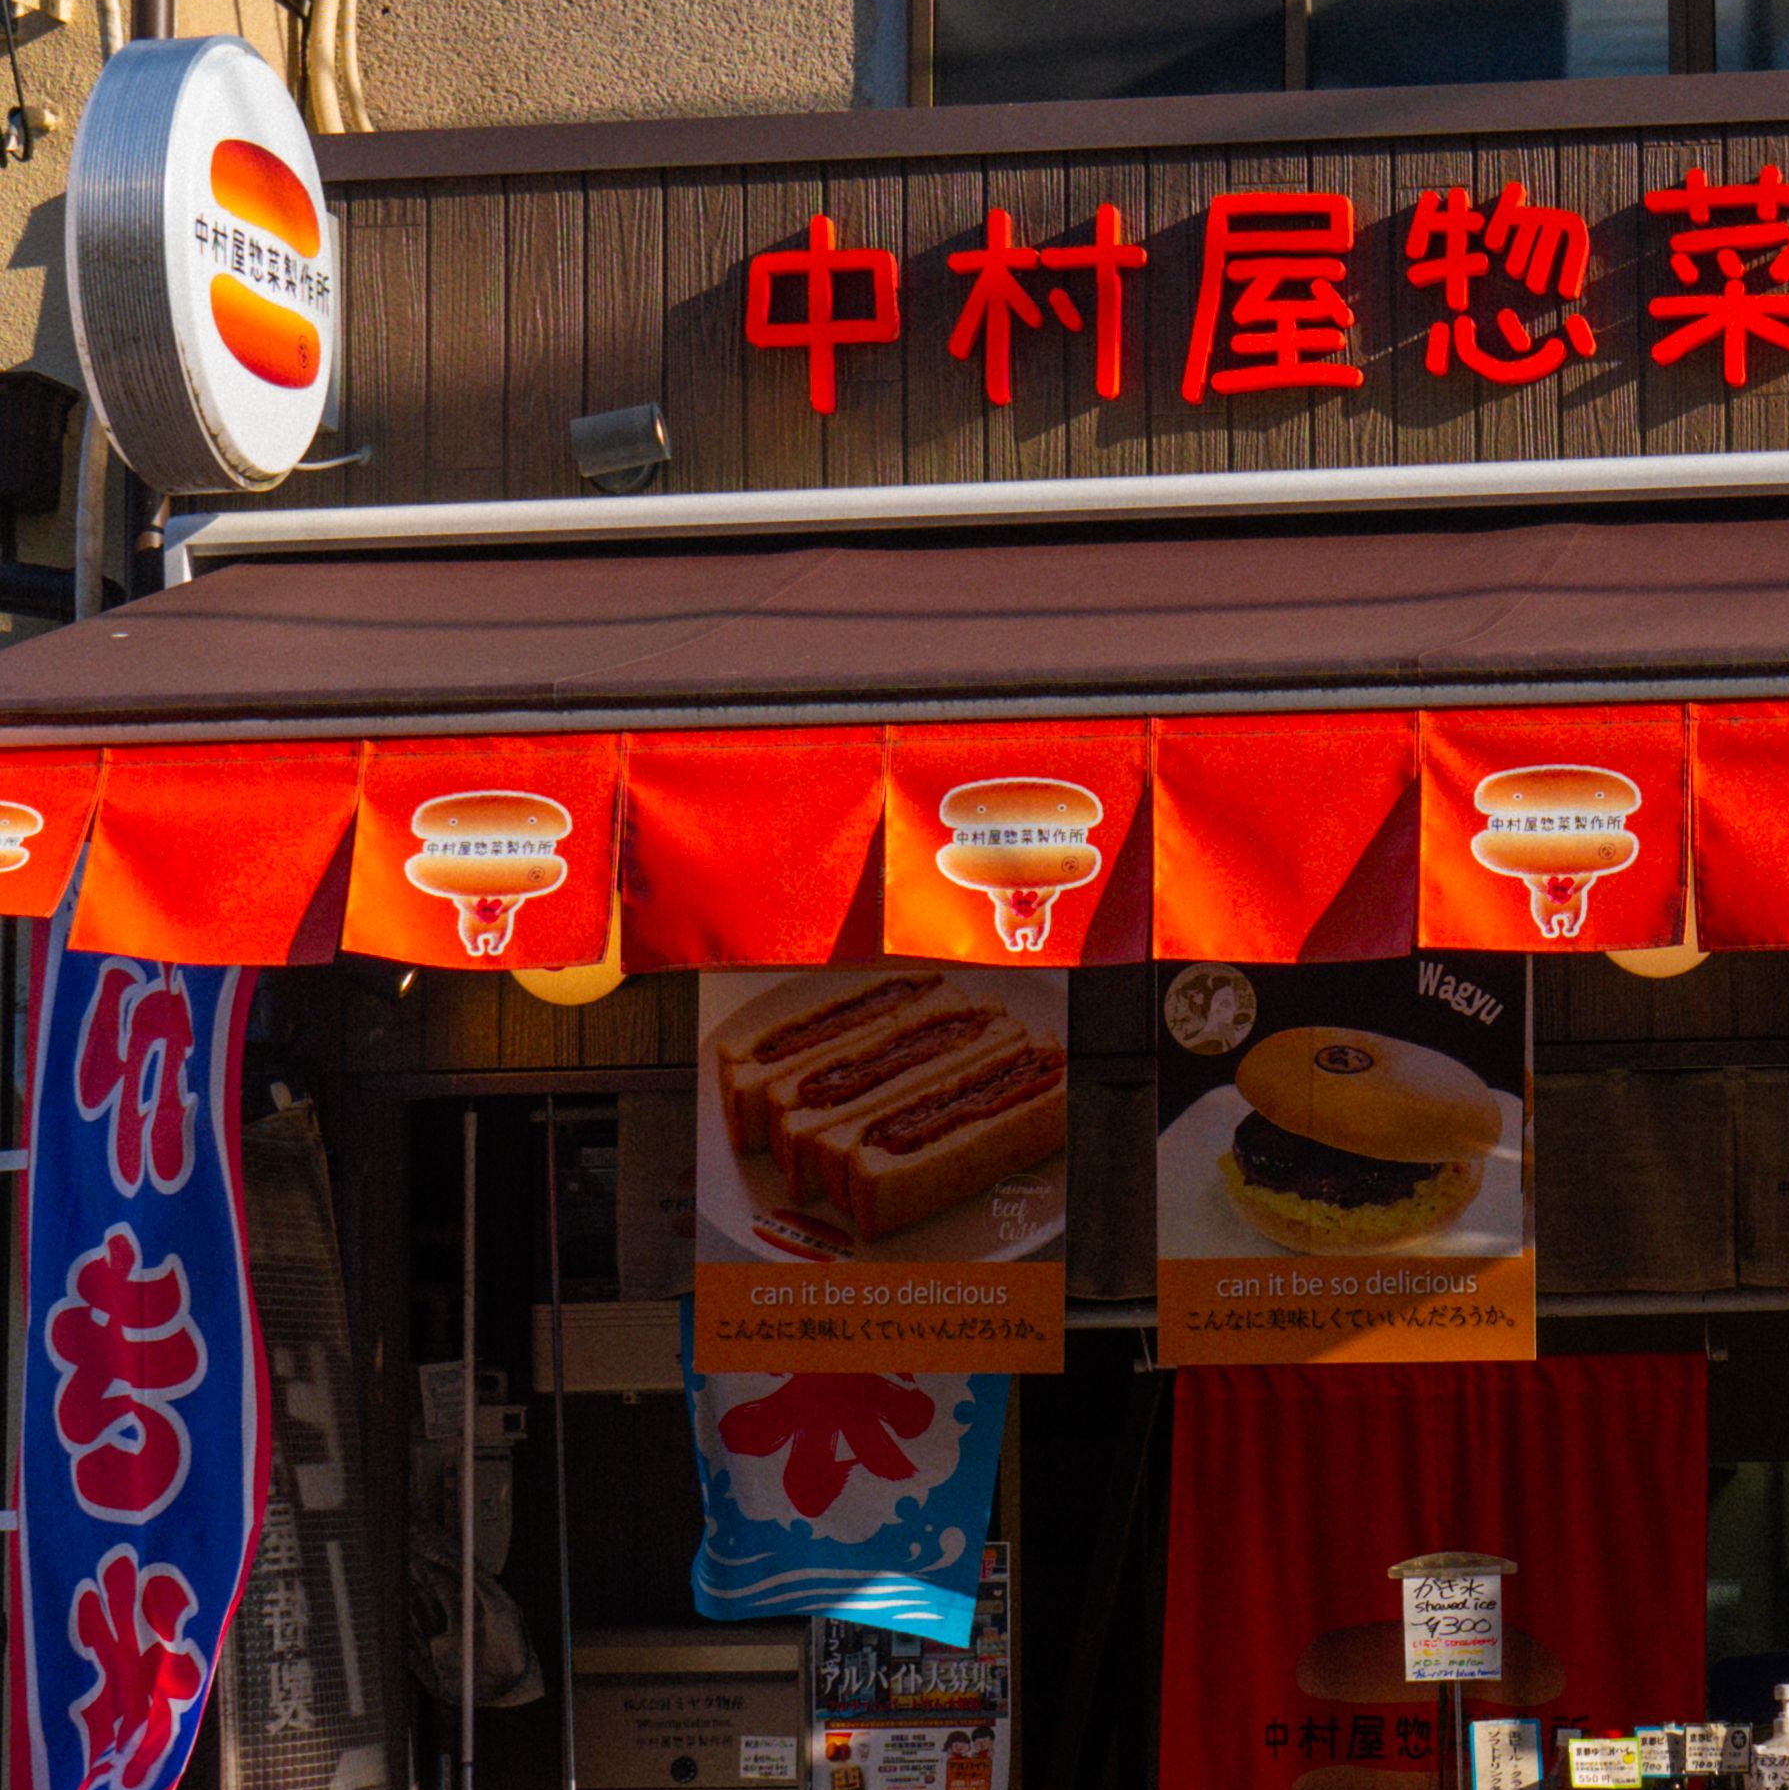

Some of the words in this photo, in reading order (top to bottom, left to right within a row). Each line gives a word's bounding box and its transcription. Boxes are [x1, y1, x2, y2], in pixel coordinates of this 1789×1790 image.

[196, 213, 330, 315] 中村屋惣菜製作所
[1491, 815, 1622, 832] 中村屋惣菜製作所
[427, 840, 553, 856] 中村屋惣菜製作所
[956, 828, 1085, 845] 中村屋惣菜製作所
[1417, 959, 1505, 1027] Wagyu
[751, 1286, 794, 1305] can
[802, 1281, 816, 1304] it
[825, 1281, 856, 1305] be
[863, 1286, 890, 1305] so
[896, 1280, 1007, 1305] delicious
[1216, 1278, 1260, 1297] can
[1268, 1273, 1284, 1296] it
[1292, 1271, 1323, 1296] be
[1330, 1276, 1358, 1295] so
[1366, 1270, 1478, 1295] delicious
[1413, 1576, 1485, 1600] かき氷
[1474, 1597, 1497, 1611] ice
